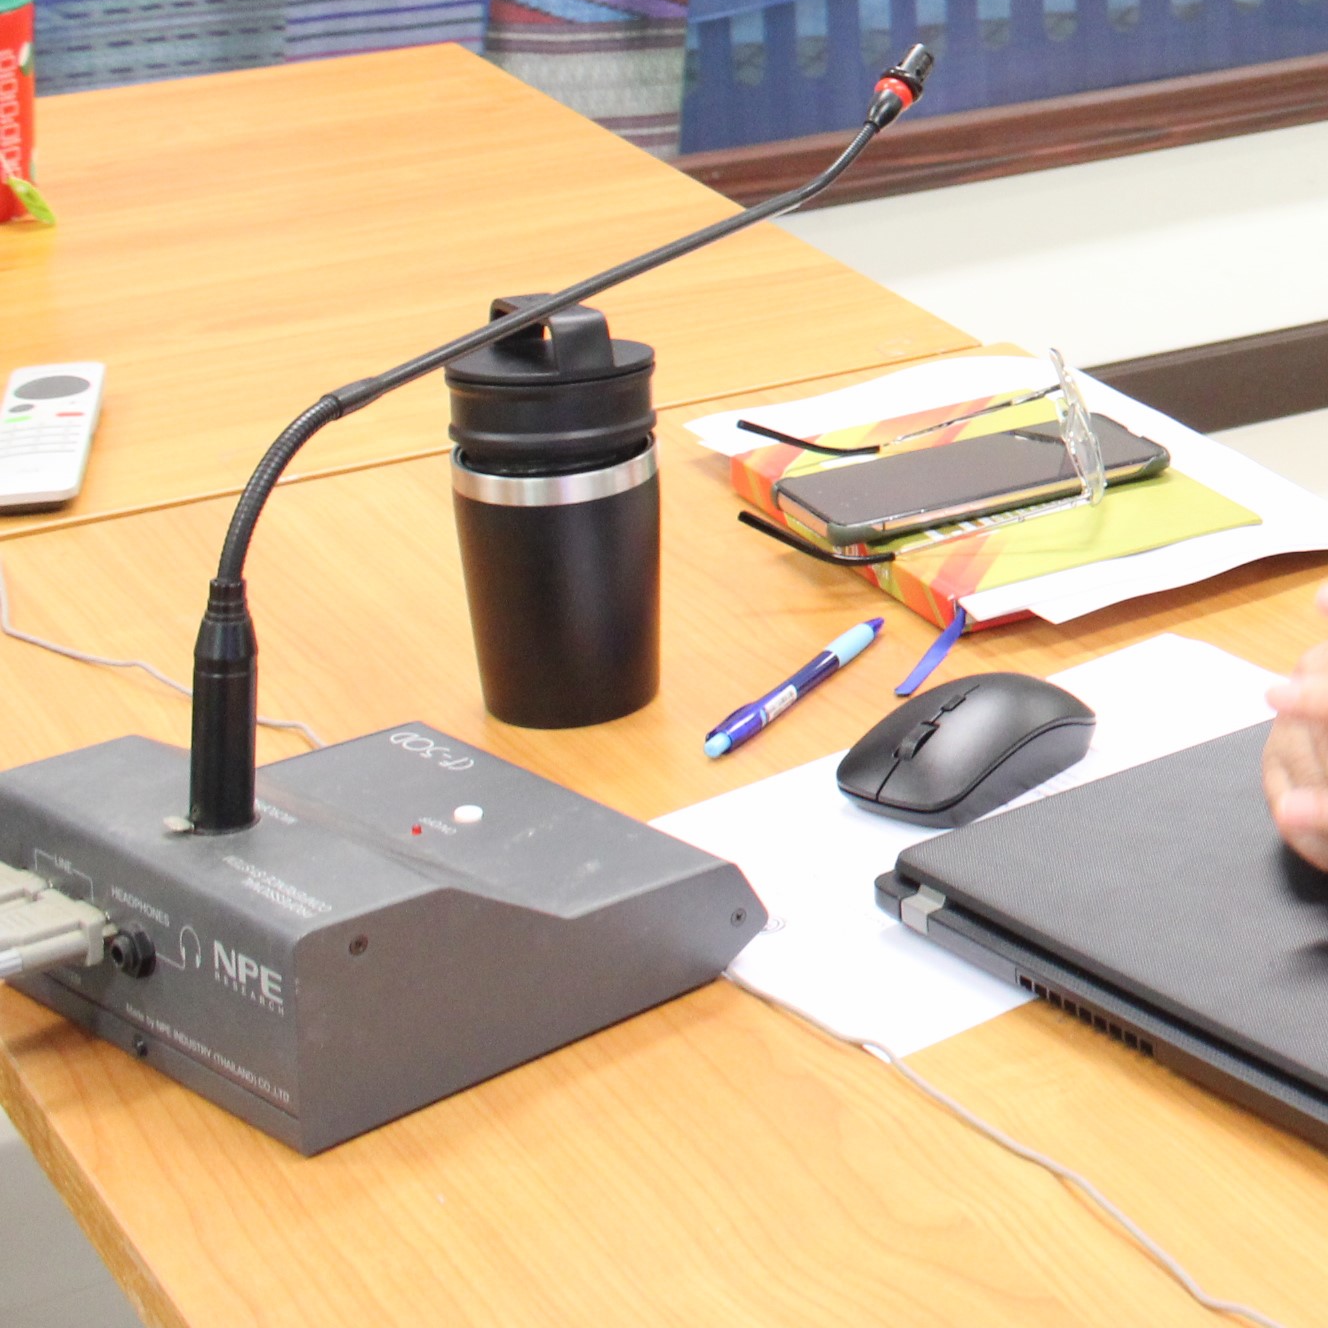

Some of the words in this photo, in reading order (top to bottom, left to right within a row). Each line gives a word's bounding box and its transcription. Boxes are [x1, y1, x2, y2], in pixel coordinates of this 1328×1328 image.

[110, 884, 170, 928] HEADPHONES
[213, 938, 284, 1006] NPE
[214, 970, 285, 1017] RESEARCH
